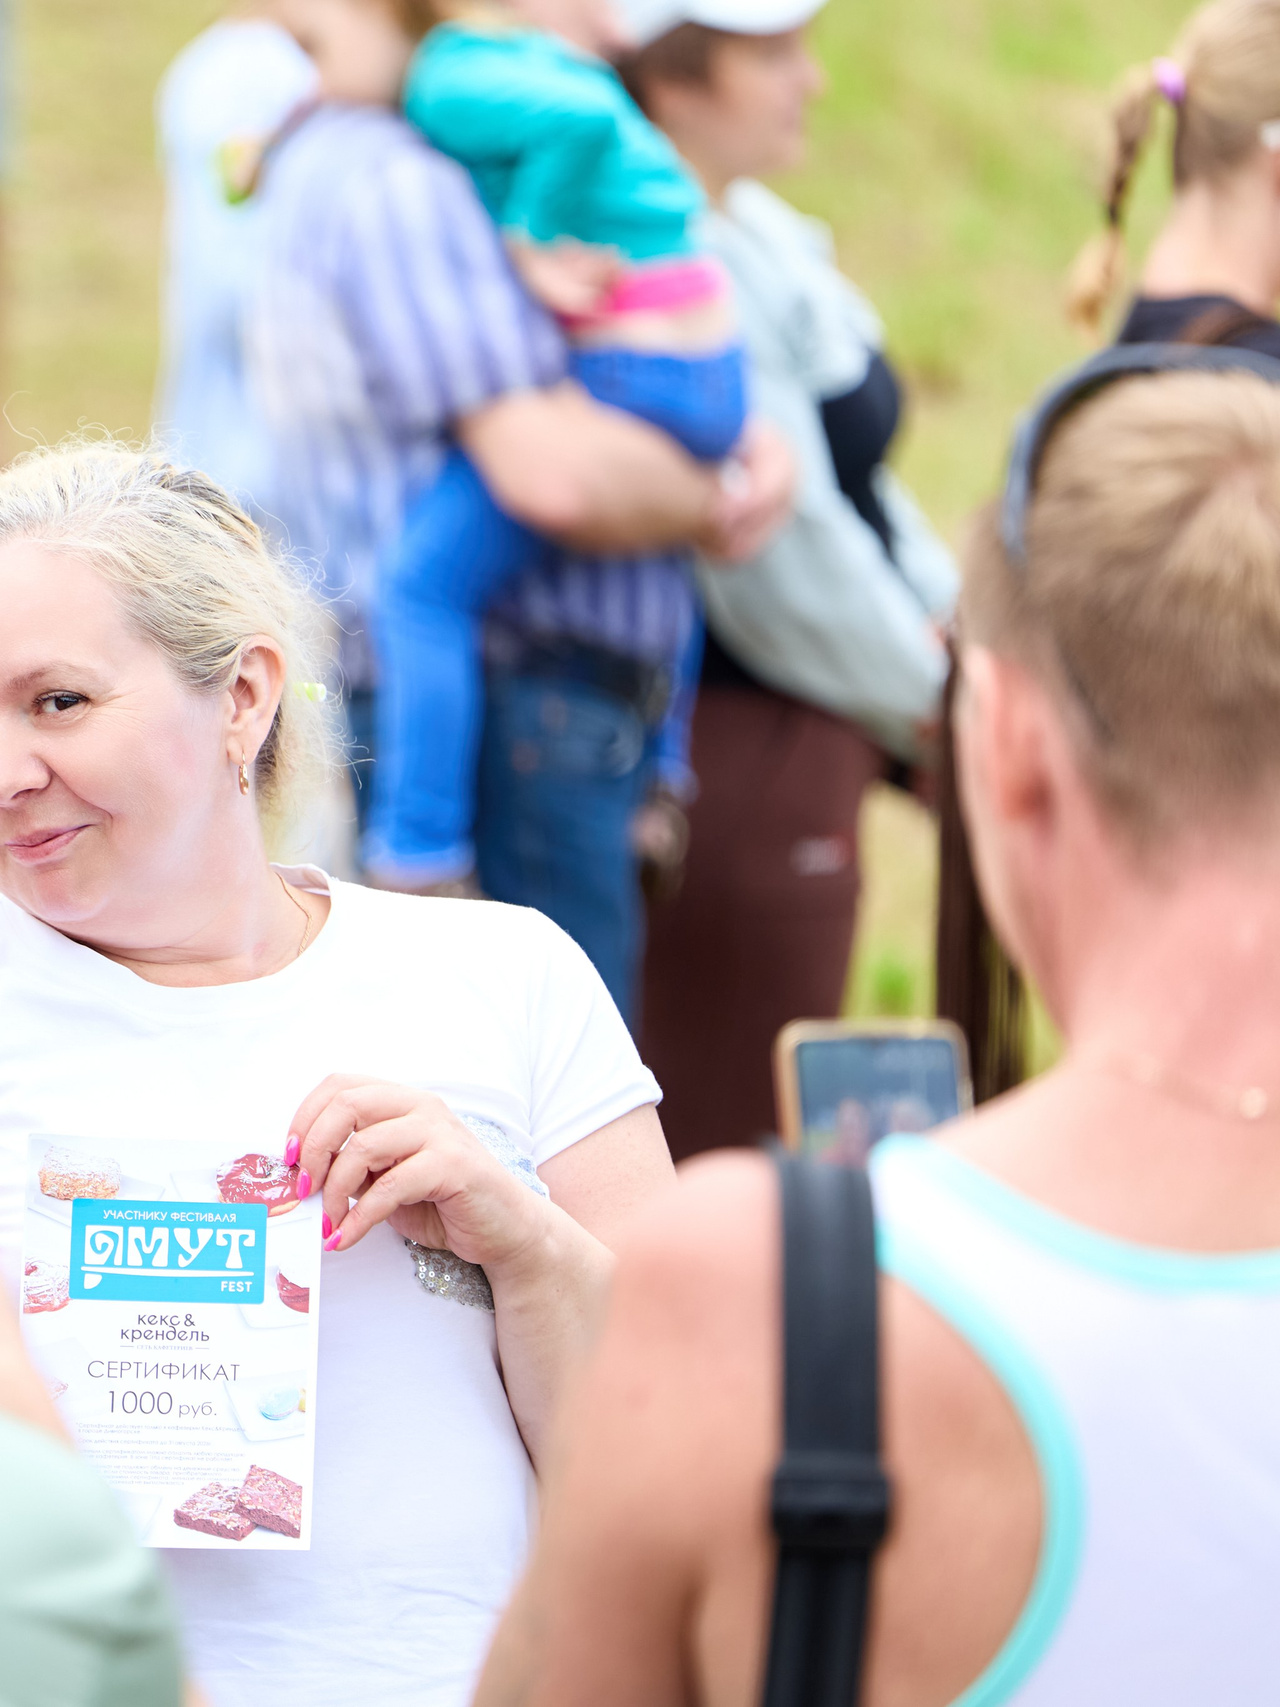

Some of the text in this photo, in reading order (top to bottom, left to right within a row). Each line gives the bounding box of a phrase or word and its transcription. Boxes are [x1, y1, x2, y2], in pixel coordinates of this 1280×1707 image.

[103, 1210, 236, 1223] УЧАСТНИКУ ФЕСТИВАЛЯ
[221, 1281, 252, 1293] FEST
[138, 1313, 195, 1327] кекс &
[121, 1325, 210, 1342] крендель
[87, 1360, 240, 1381] СЕРТИФИКАТ
[109, 1391, 217, 1418] 1000 руб.
